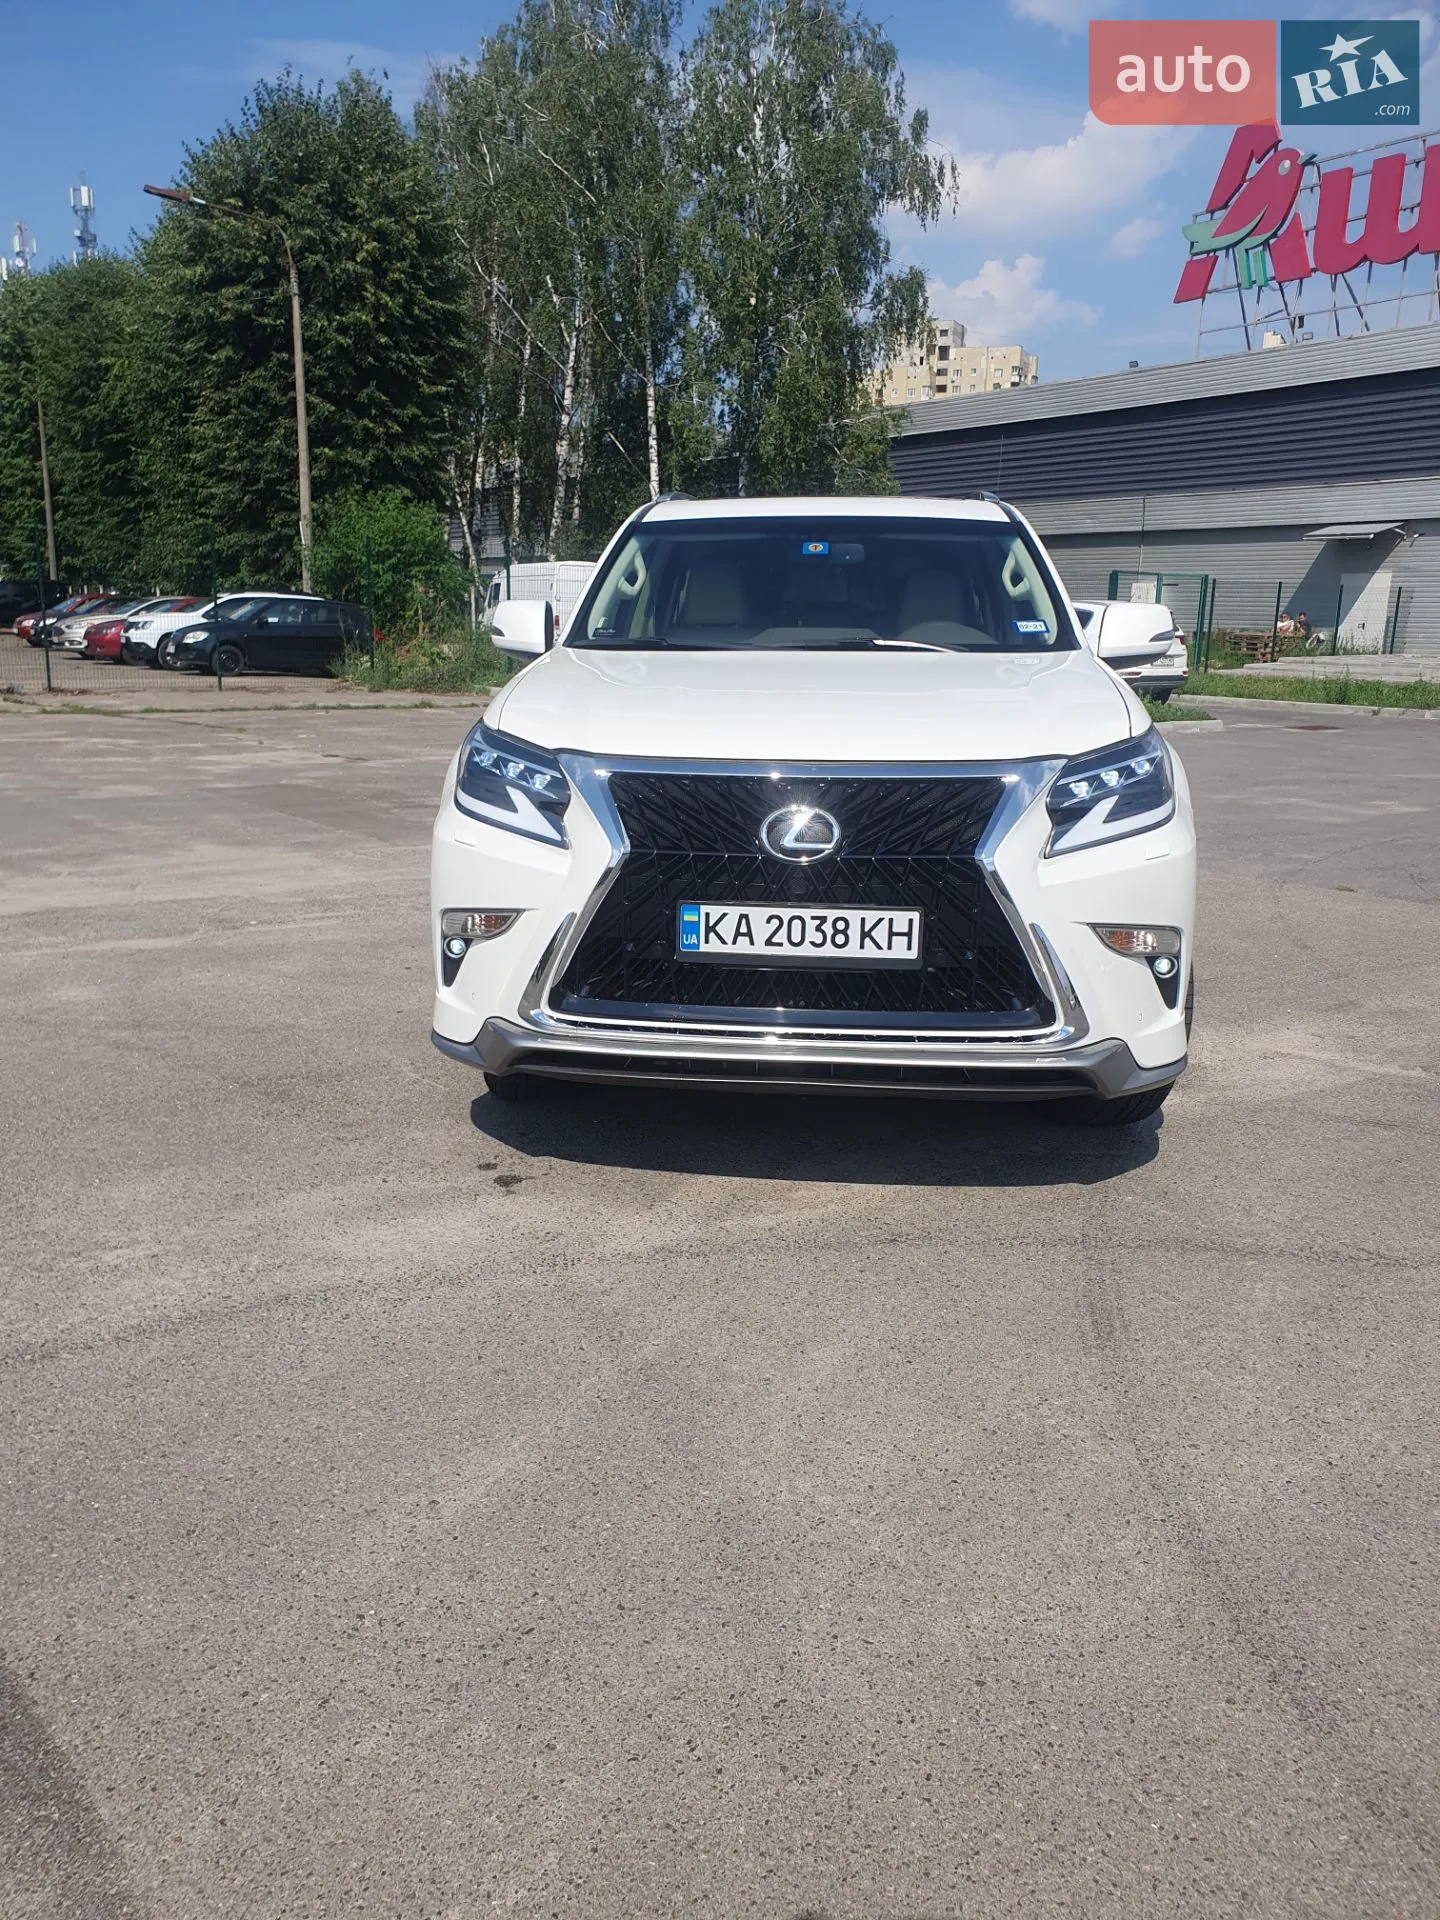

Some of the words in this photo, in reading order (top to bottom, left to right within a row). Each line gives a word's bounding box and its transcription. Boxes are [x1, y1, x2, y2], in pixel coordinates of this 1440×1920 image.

[683, 934, 698, 945] UA
[704, 911, 755, 946] KA
[764, 914, 850, 949] 2038
[859, 917, 914, 951] KH
